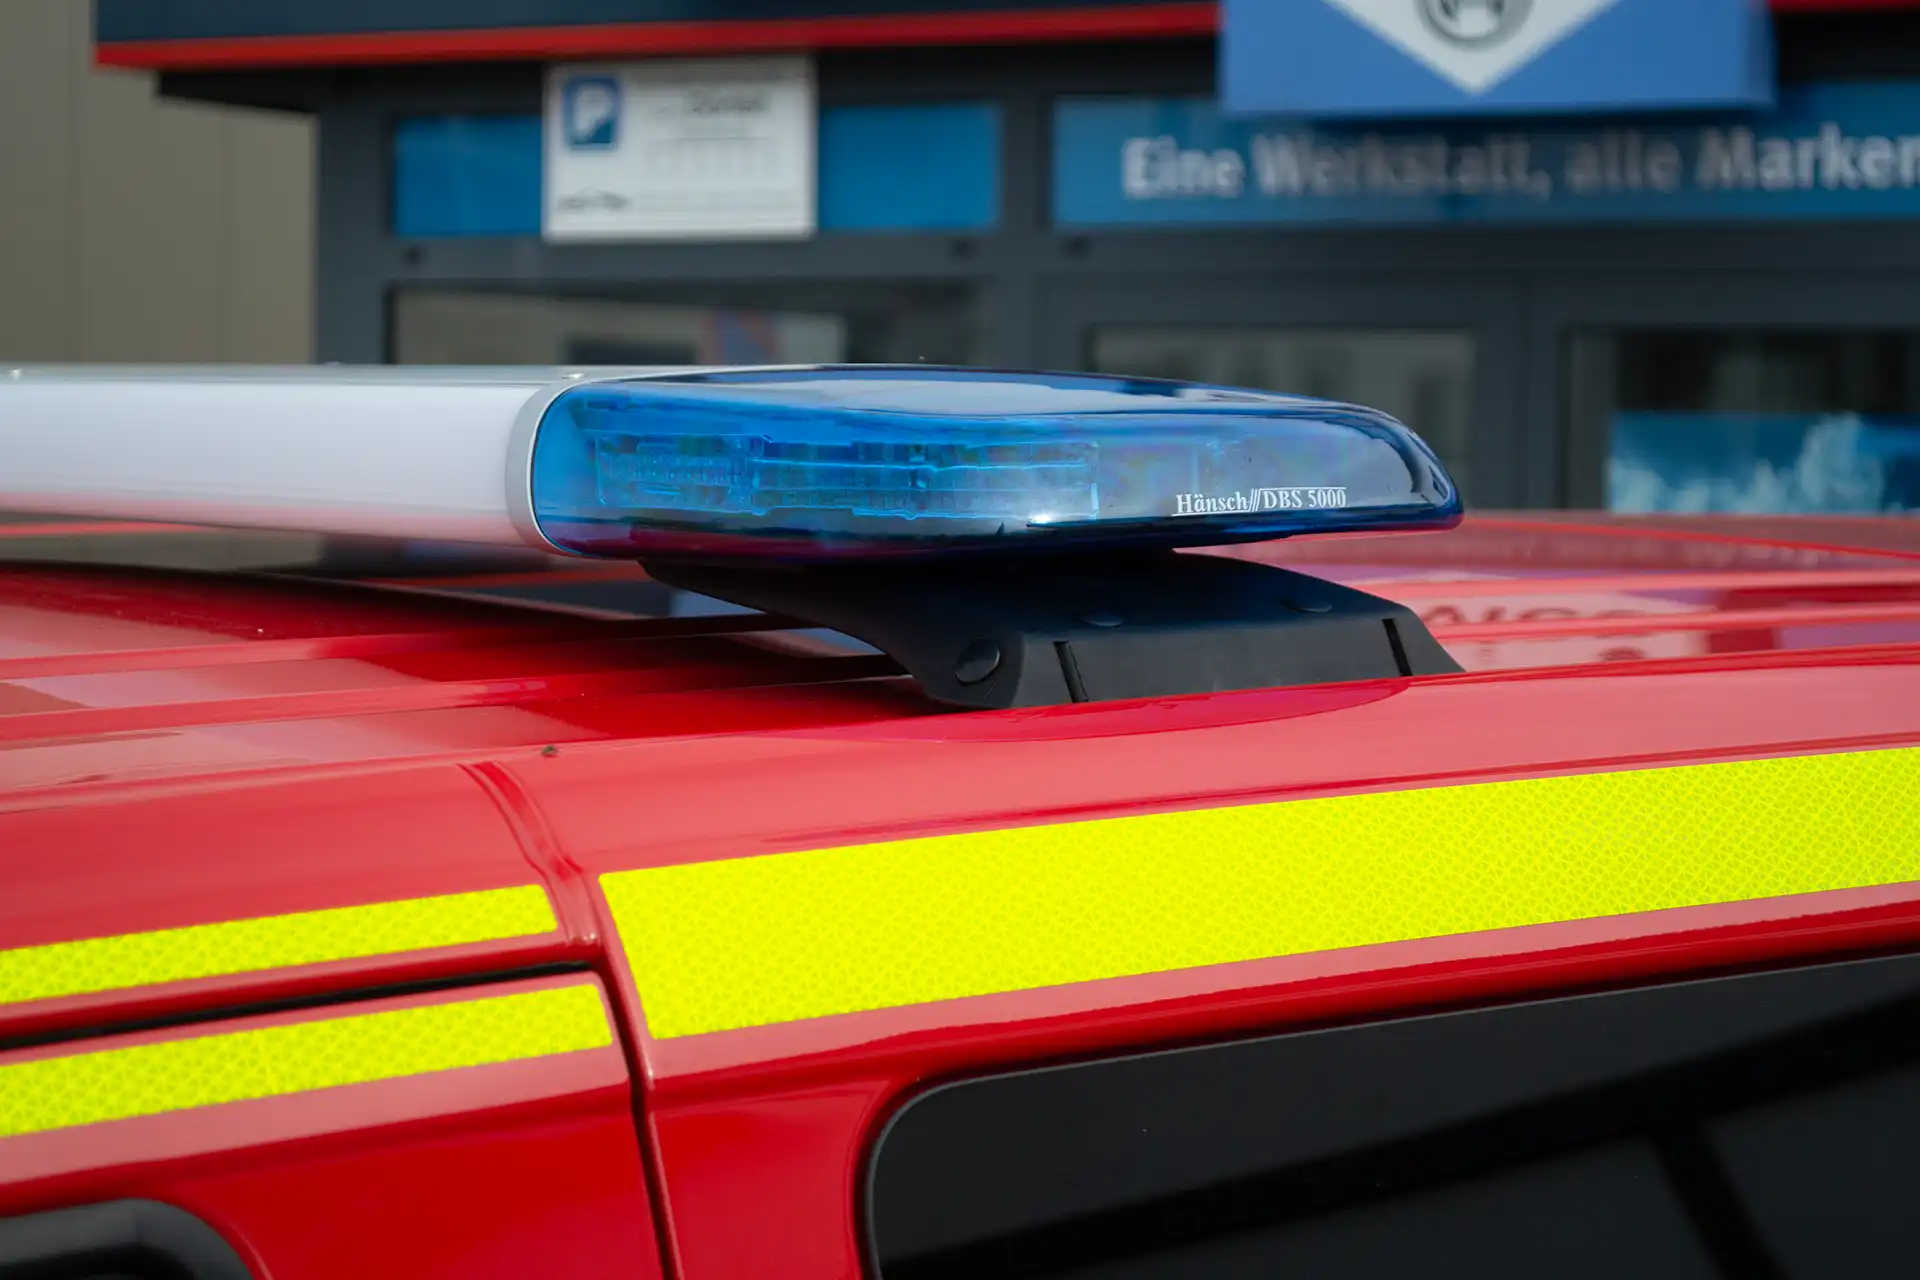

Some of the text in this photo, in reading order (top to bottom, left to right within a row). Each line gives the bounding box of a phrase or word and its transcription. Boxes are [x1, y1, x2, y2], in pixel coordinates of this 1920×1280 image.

[573, 82, 611, 142] P
[1123, 136, 1243, 198] Eine
[1565, 131, 1681, 193] alle
[1175, 488, 1346, 514] Hänsch DBS 5000
